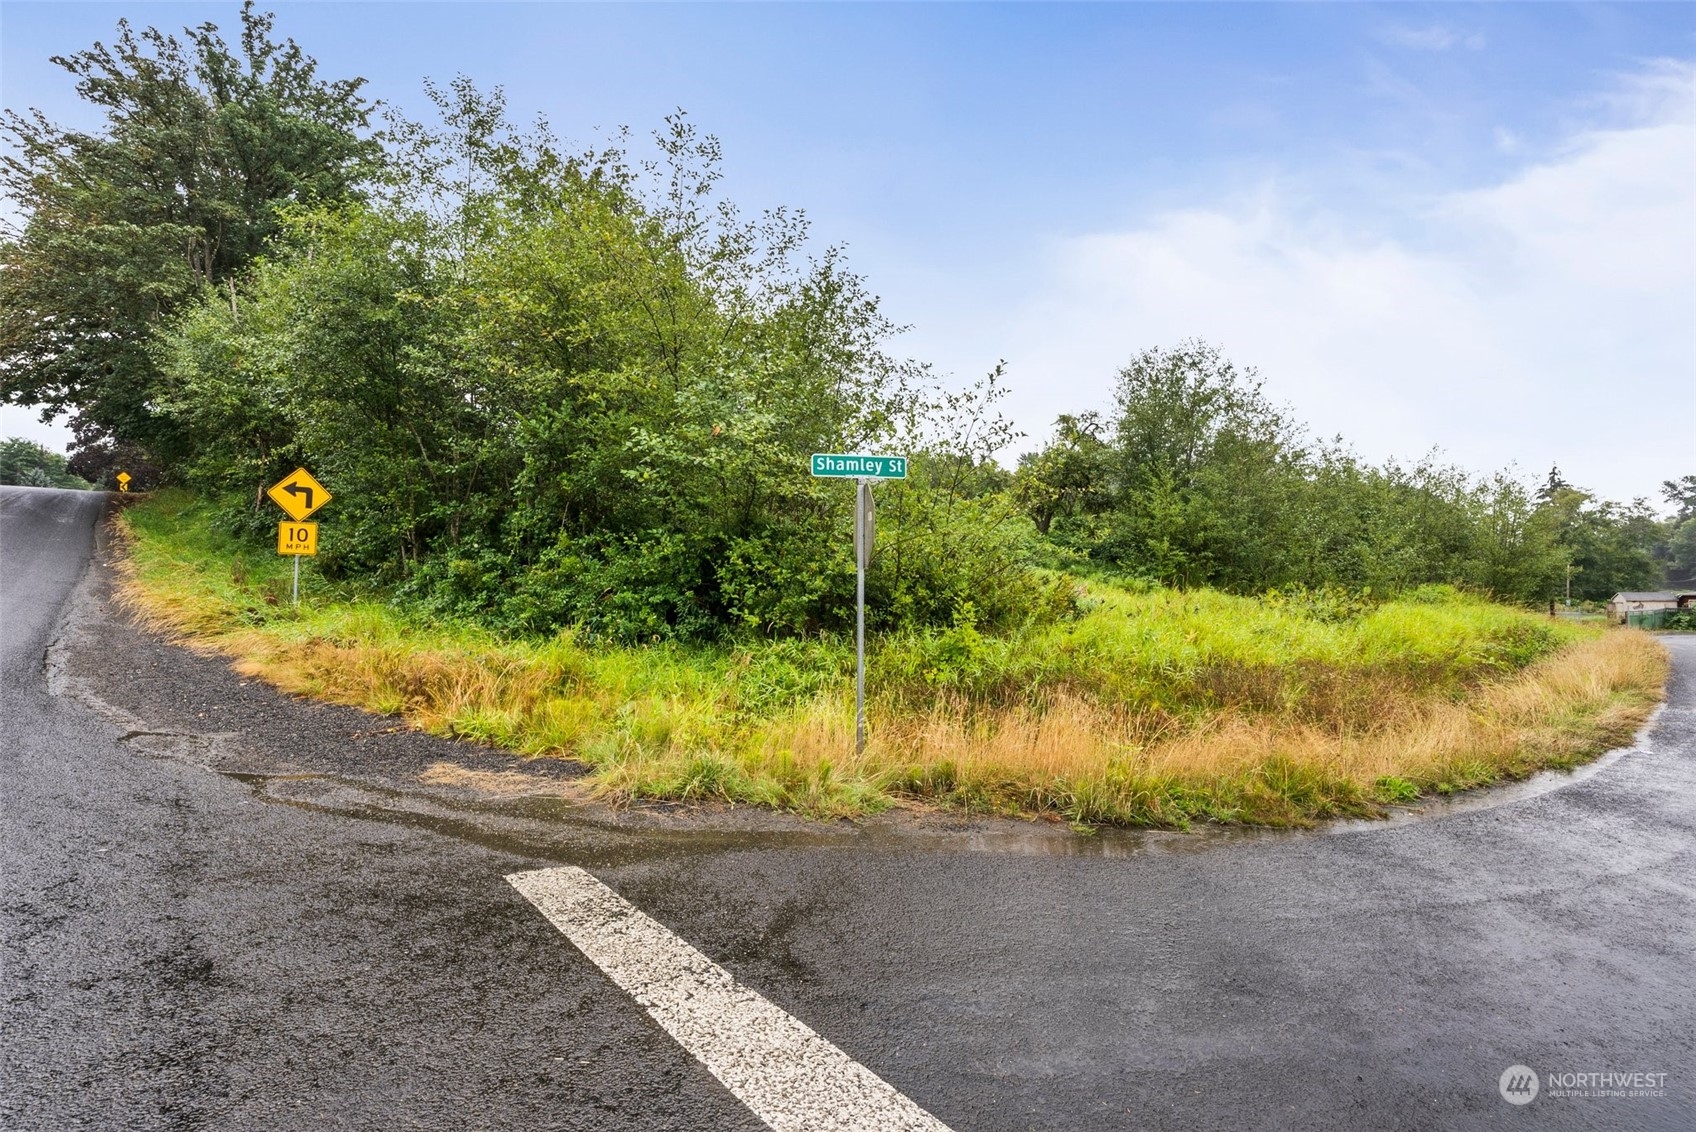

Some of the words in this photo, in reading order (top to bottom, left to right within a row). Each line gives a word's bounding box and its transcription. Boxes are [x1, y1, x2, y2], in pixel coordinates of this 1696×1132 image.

[816, 457, 882, 475] Shamley
[889, 460, 902, 472] St
[289, 528, 308, 542] 10
